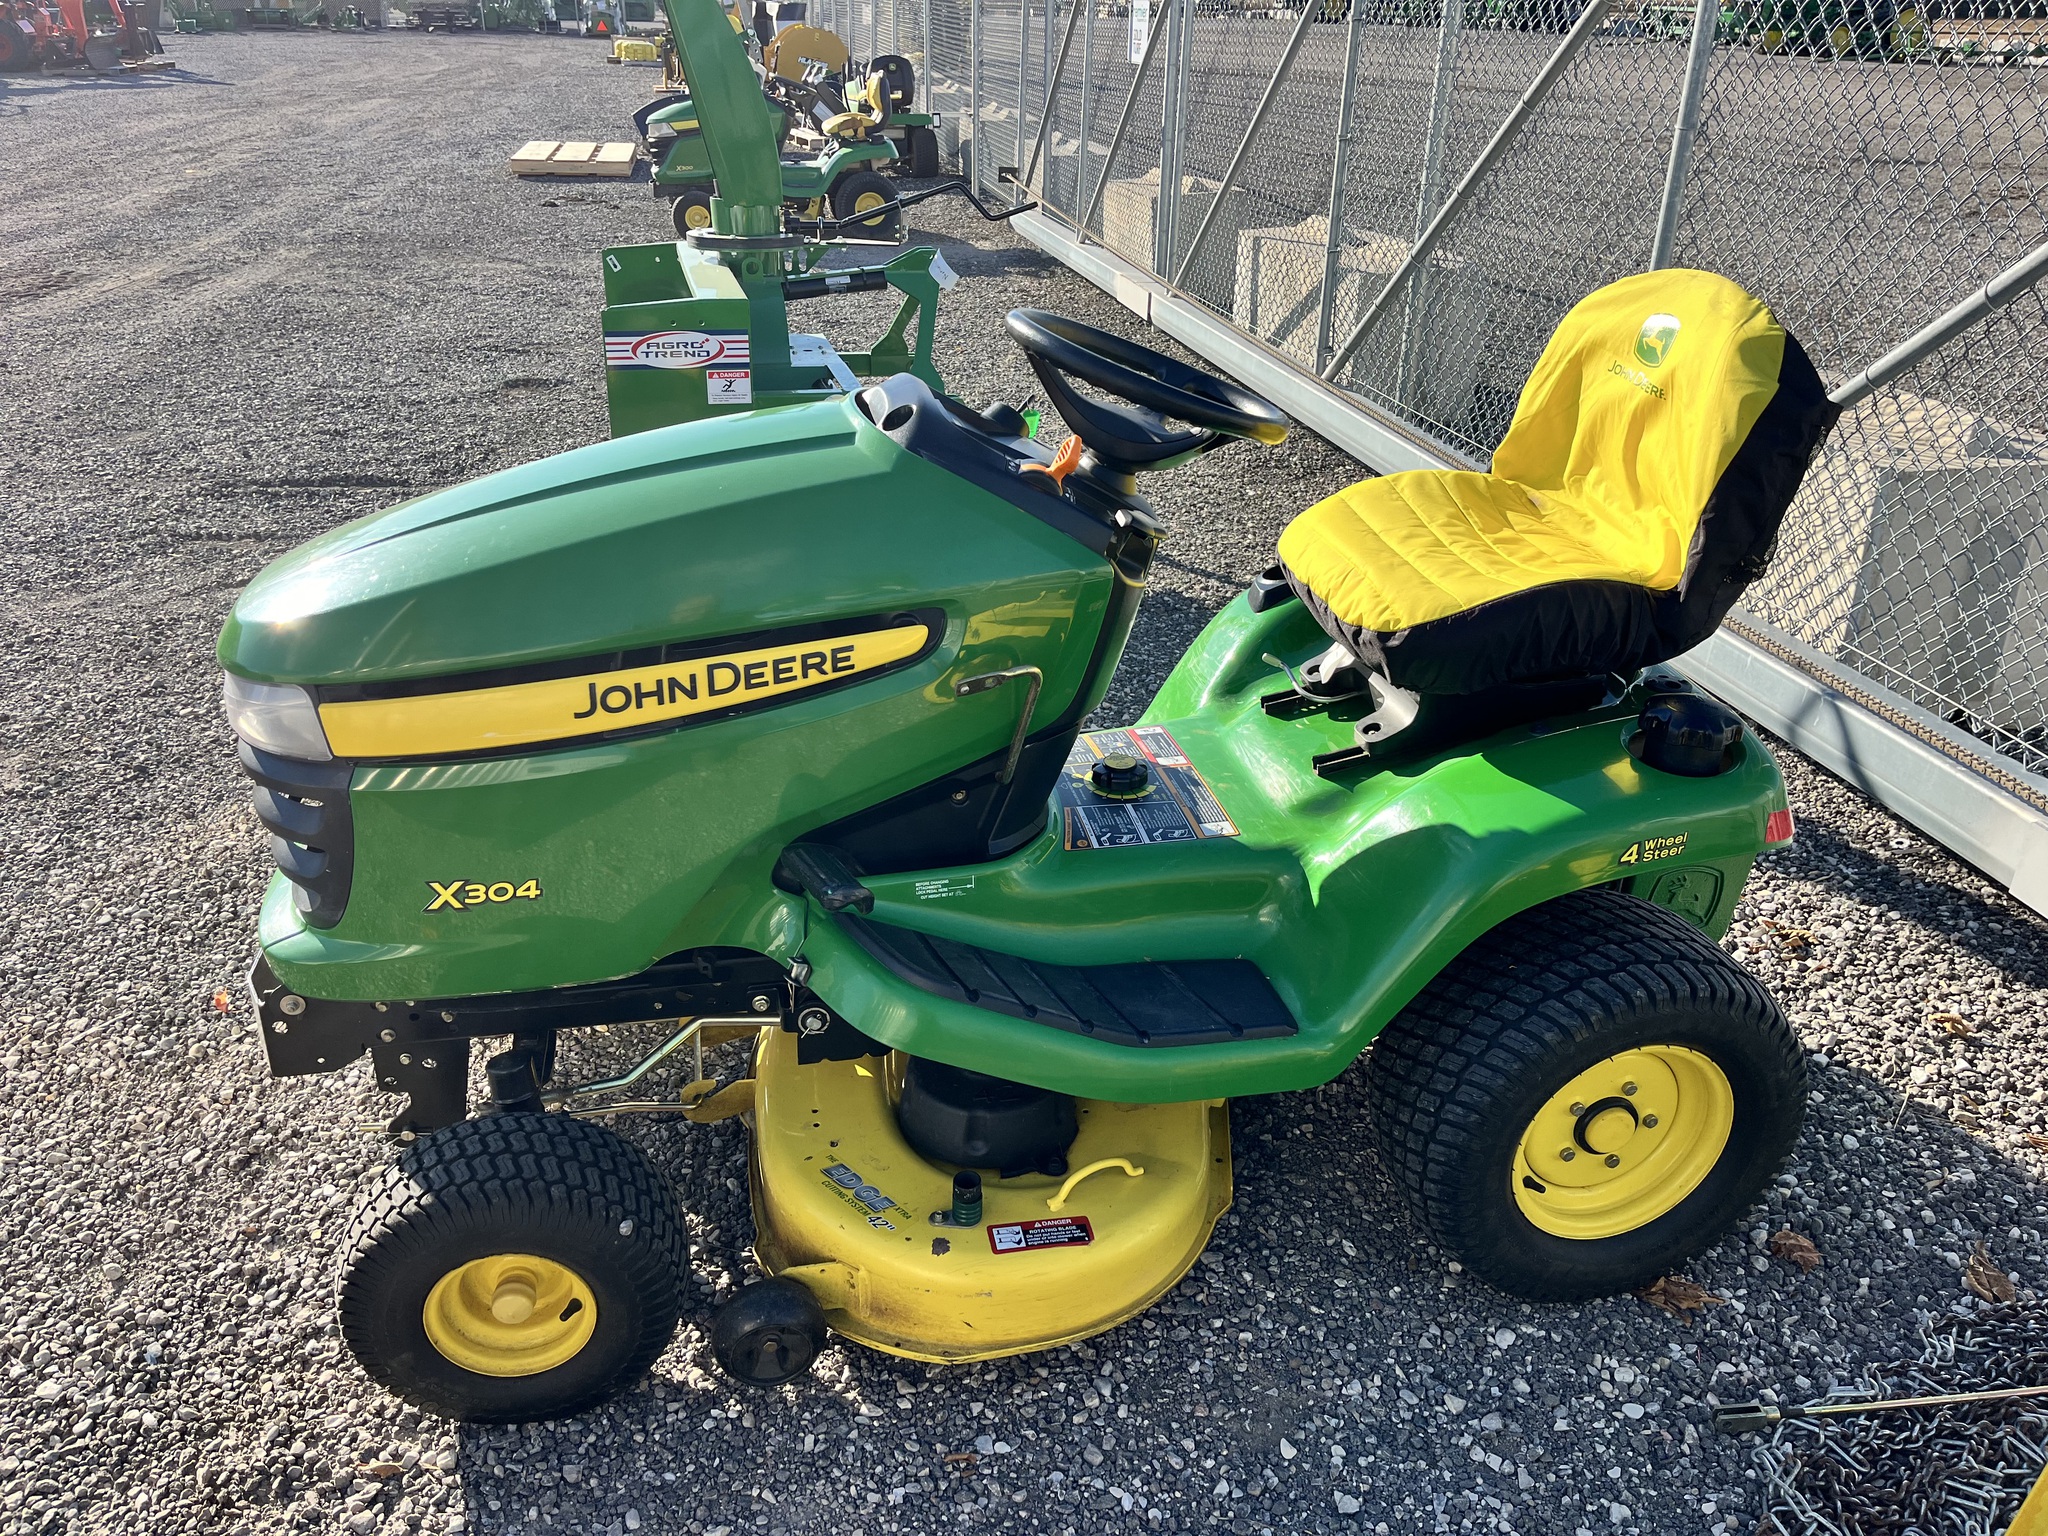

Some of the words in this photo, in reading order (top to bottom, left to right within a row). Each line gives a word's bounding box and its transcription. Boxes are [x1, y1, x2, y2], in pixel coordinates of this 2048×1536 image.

[641, 350, 710, 358] TREND
[646, 341, 704, 349] AGRO
[1607, 360, 1633, 382] JOHN
[1634, 371, 1665, 400] DEERE
[574, 674, 698, 719] JOHN
[706, 645, 855, 697] DEERE
[1620, 843, 1639, 864] 4
[1644, 832, 1688, 850] Wheel
[1642, 845, 1685, 862] Steer
[425, 879, 542, 911] X304
[825, 1154, 839, 1163] THE
[820, 1163, 897, 1213] EDGE
[821, 1180, 848, 1200] CUTTING
[844, 1196, 872, 1217] SYSTEM
[867, 1215, 896, 1231] 42"
